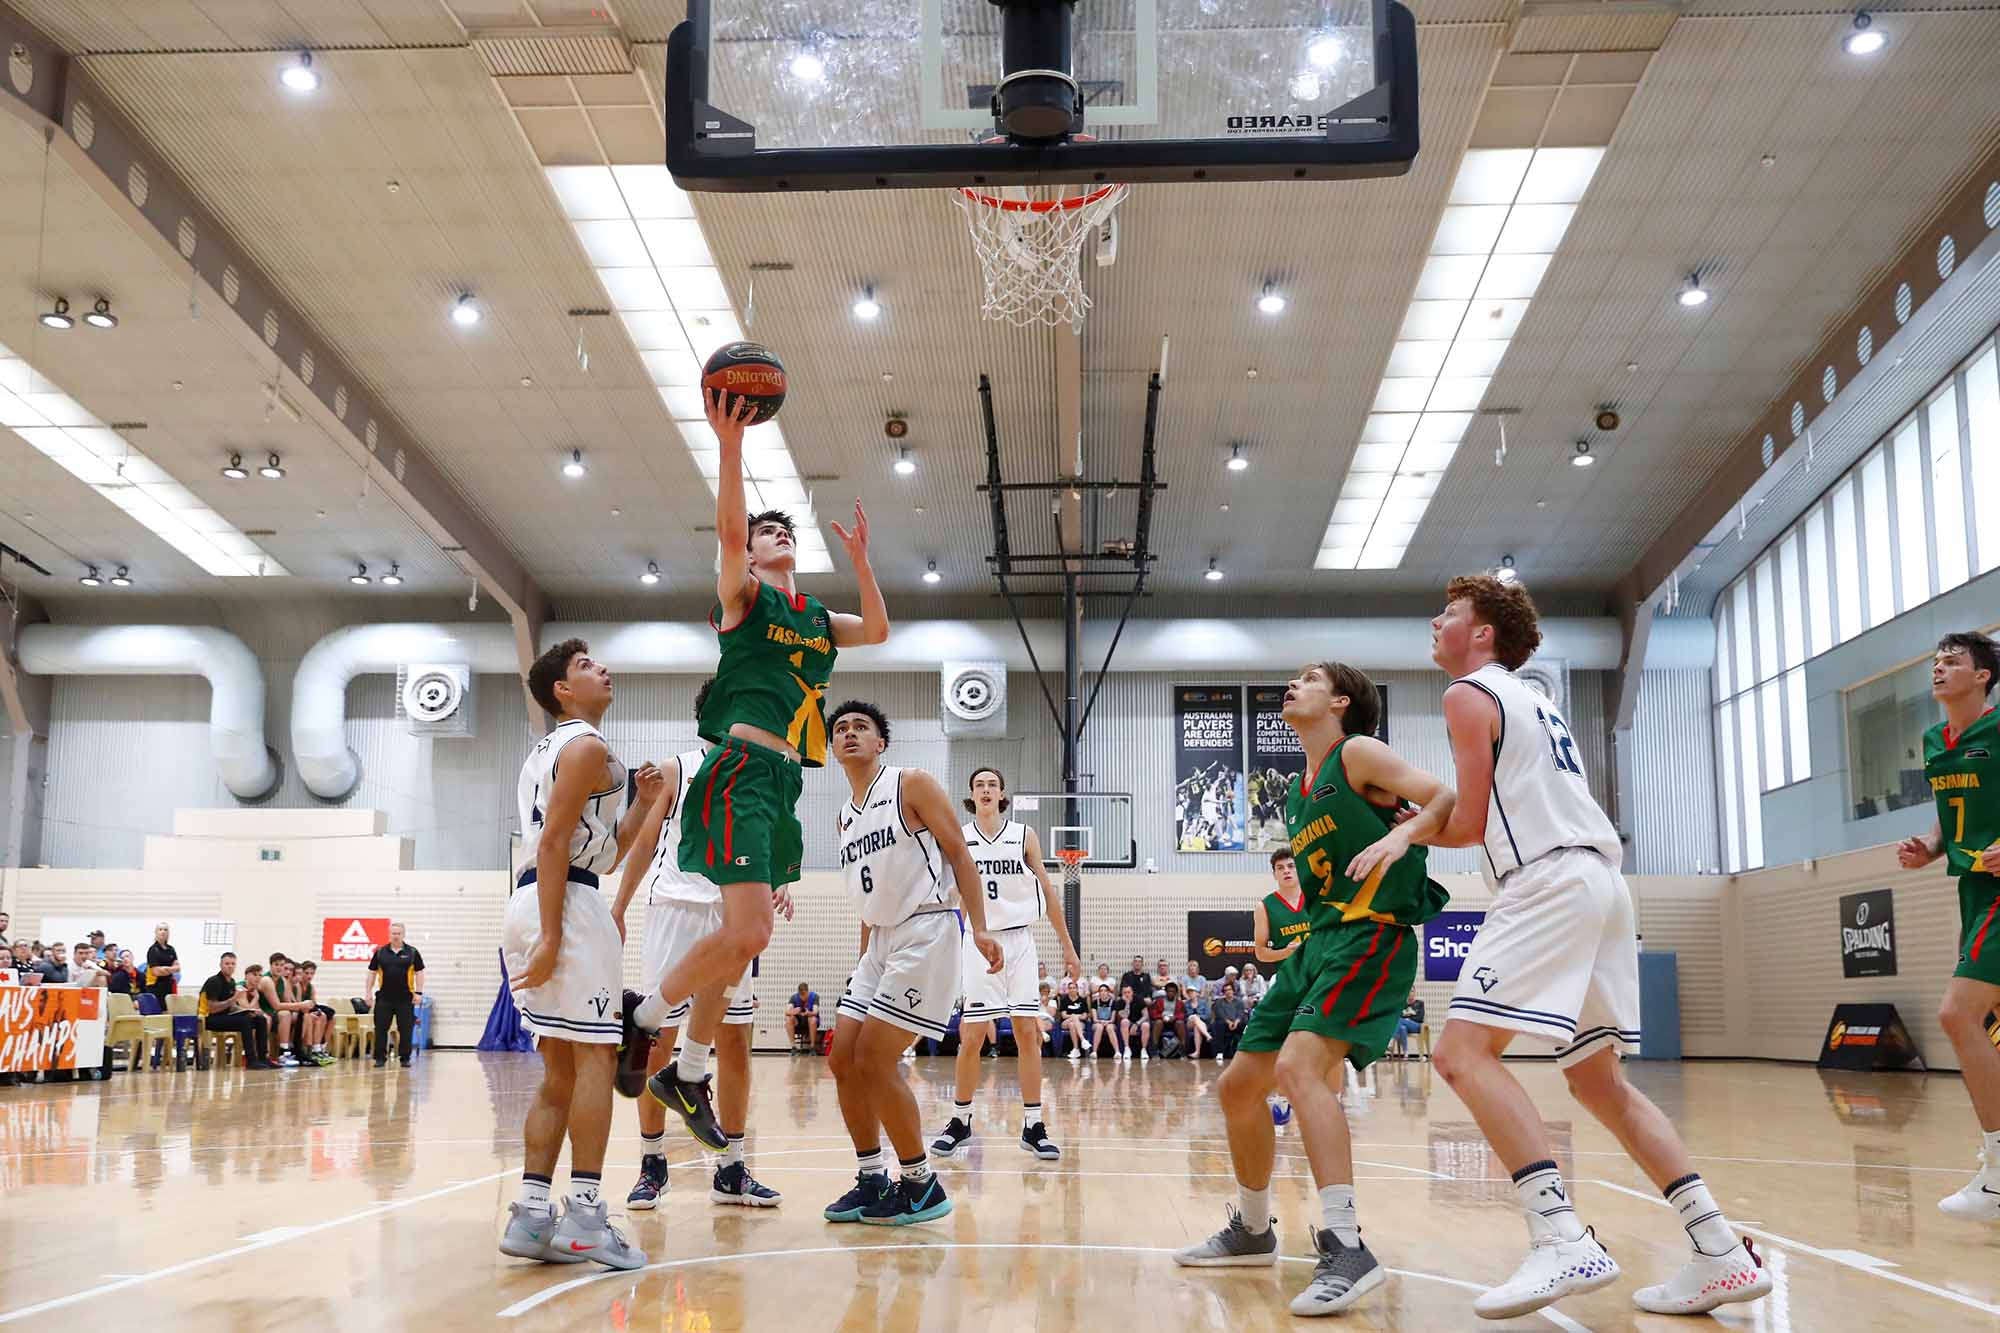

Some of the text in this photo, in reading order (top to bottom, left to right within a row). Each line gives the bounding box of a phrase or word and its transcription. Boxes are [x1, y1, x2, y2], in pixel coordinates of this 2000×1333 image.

[1183, 712, 1233, 720] AUSTRALIAN
[1183, 720, 1233, 730] PLAYERS
[1183, 730, 1233, 739] ARE GREAT
[1183, 739, 1233, 747] DEFENDERS
[1948, 797, 1964, 843] 7
[861, 866, 873, 893] 6
[987, 881, 998, 900] 9
[1843, 921, 1890, 955] SPALDING
[332, 944, 378, 960] PEAK
[0, 1019, 81, 1072] CHAMPS
